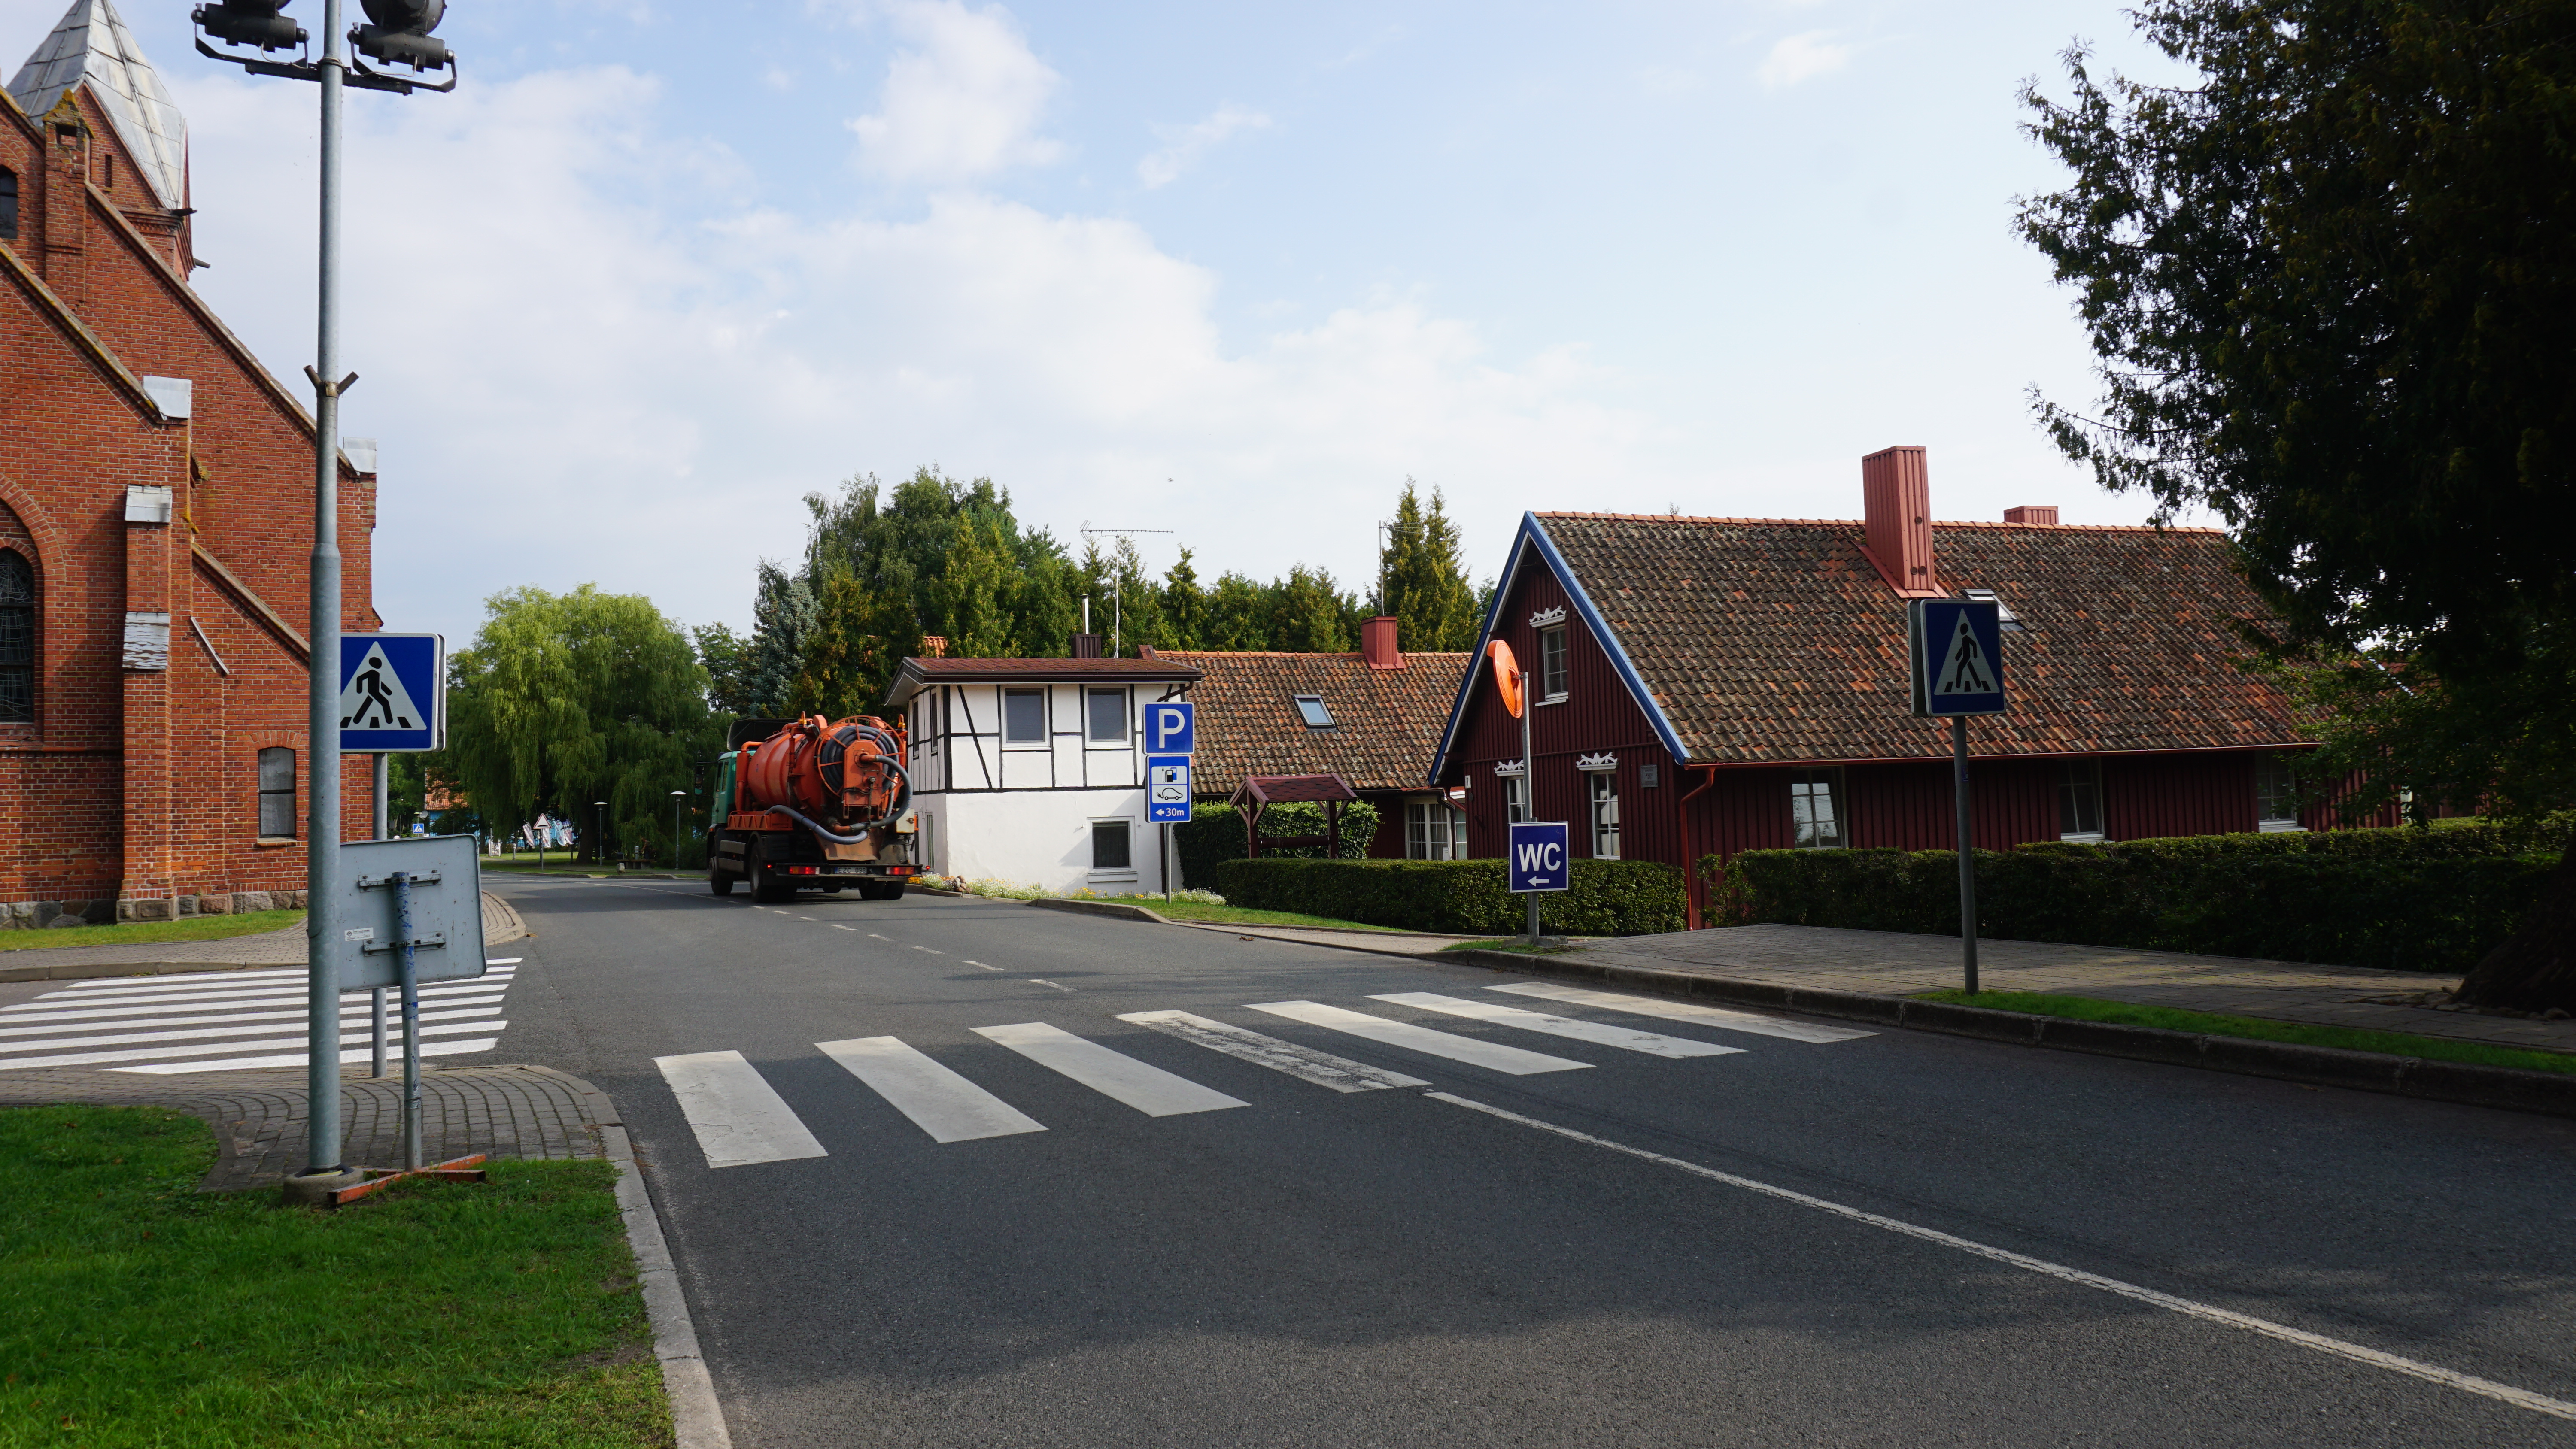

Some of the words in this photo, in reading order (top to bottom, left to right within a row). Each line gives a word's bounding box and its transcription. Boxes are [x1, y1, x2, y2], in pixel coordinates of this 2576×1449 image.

[1159, 709, 1185, 748] P
[1166, 808, 1184, 816] 30m
[1518, 843, 1561, 872] WC
